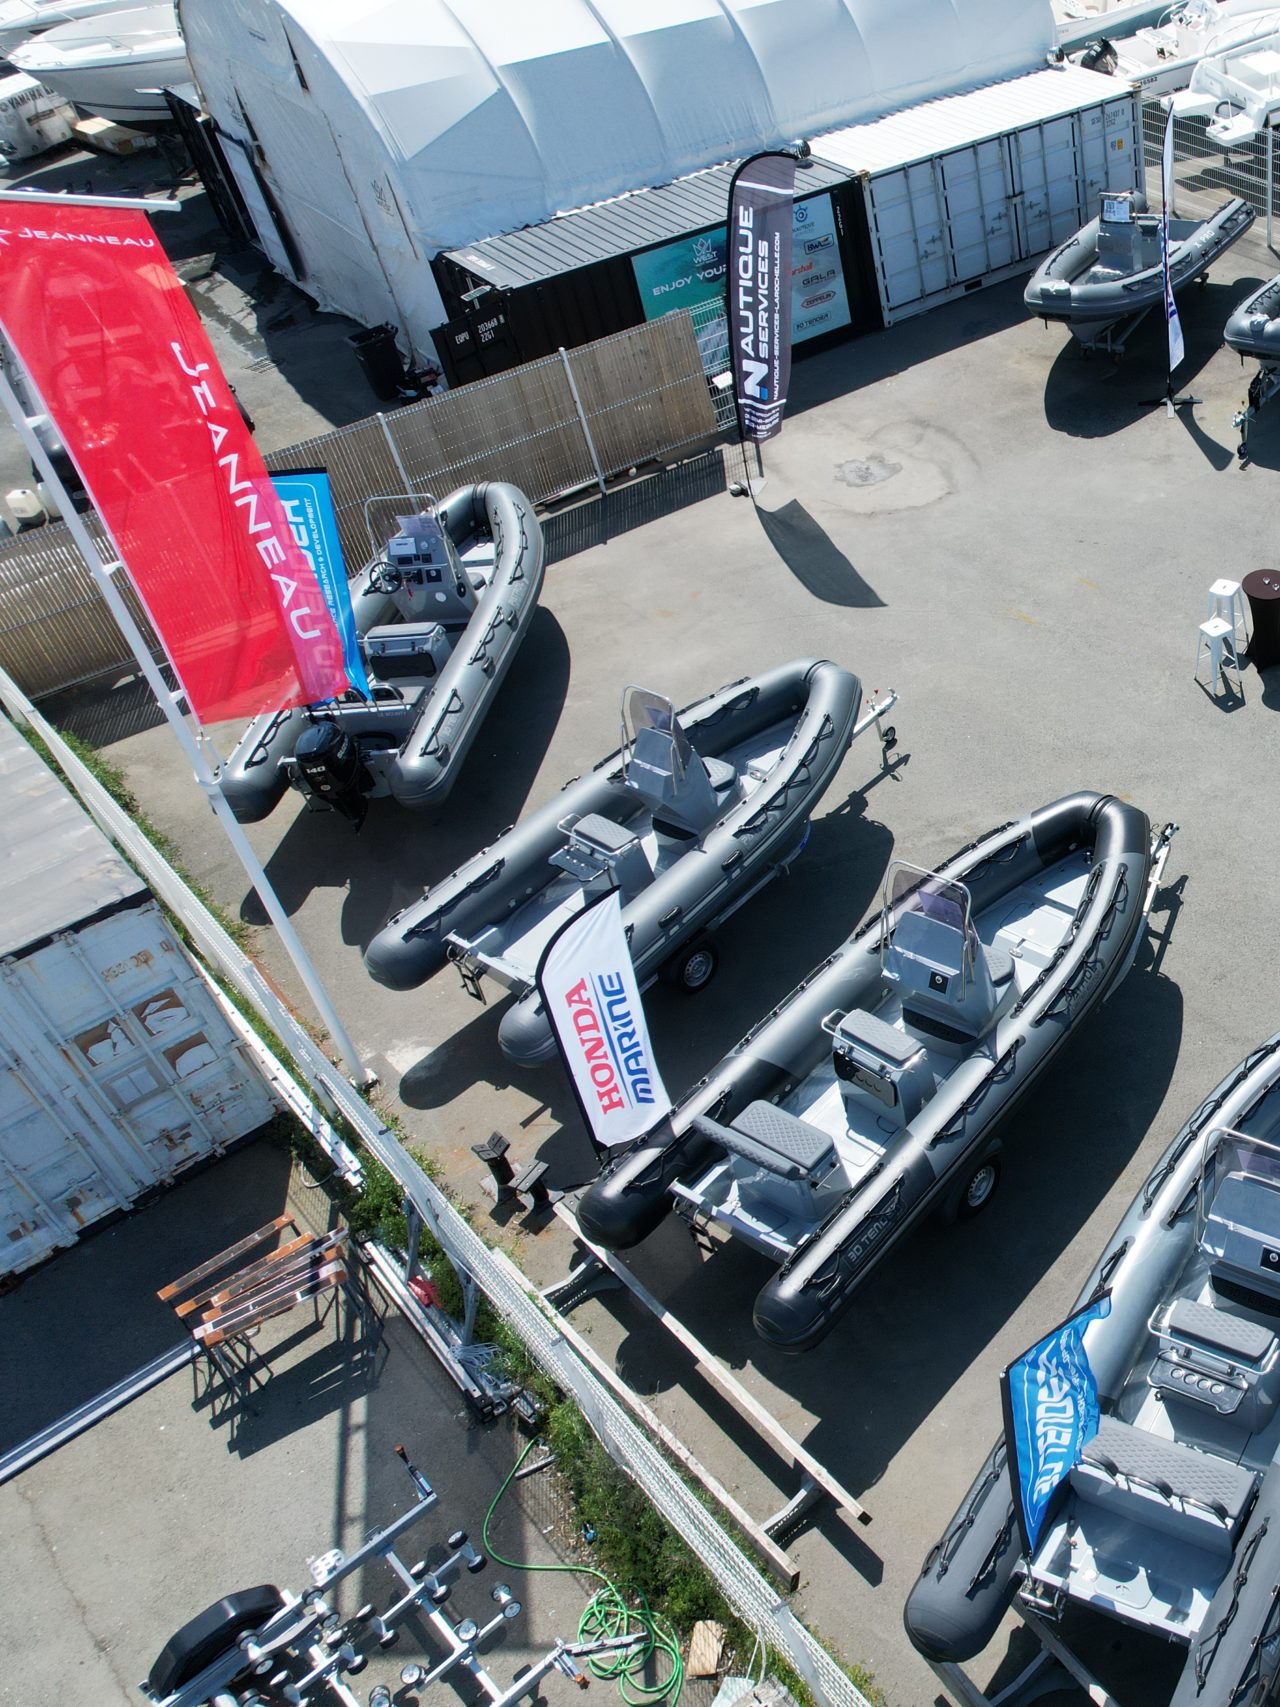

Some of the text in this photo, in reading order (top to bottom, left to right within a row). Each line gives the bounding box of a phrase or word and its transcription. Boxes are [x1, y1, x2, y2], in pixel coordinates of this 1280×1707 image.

[18, 227, 154, 248] JEANNEAU
[1199, 231, 1215, 243] PRO
[693, 251, 717, 264] WEST
[802, 269, 836, 286] GALA
[652, 276, 692, 296] ENJOY
[738, 205, 769, 400] NAUTIQUE
[758, 240, 769, 359] SERVICES
[171, 342, 320, 640] JEANNEAU
[303, 496, 323, 556] DEVELOPMENT
[306, 766, 326, 775] 140
[565, 977, 625, 1115] HONDA
[598, 971, 656, 1104] MARINE
[847, 1242, 864, 1262] 3D
[1036, 1337, 1073, 1473] TENDER
